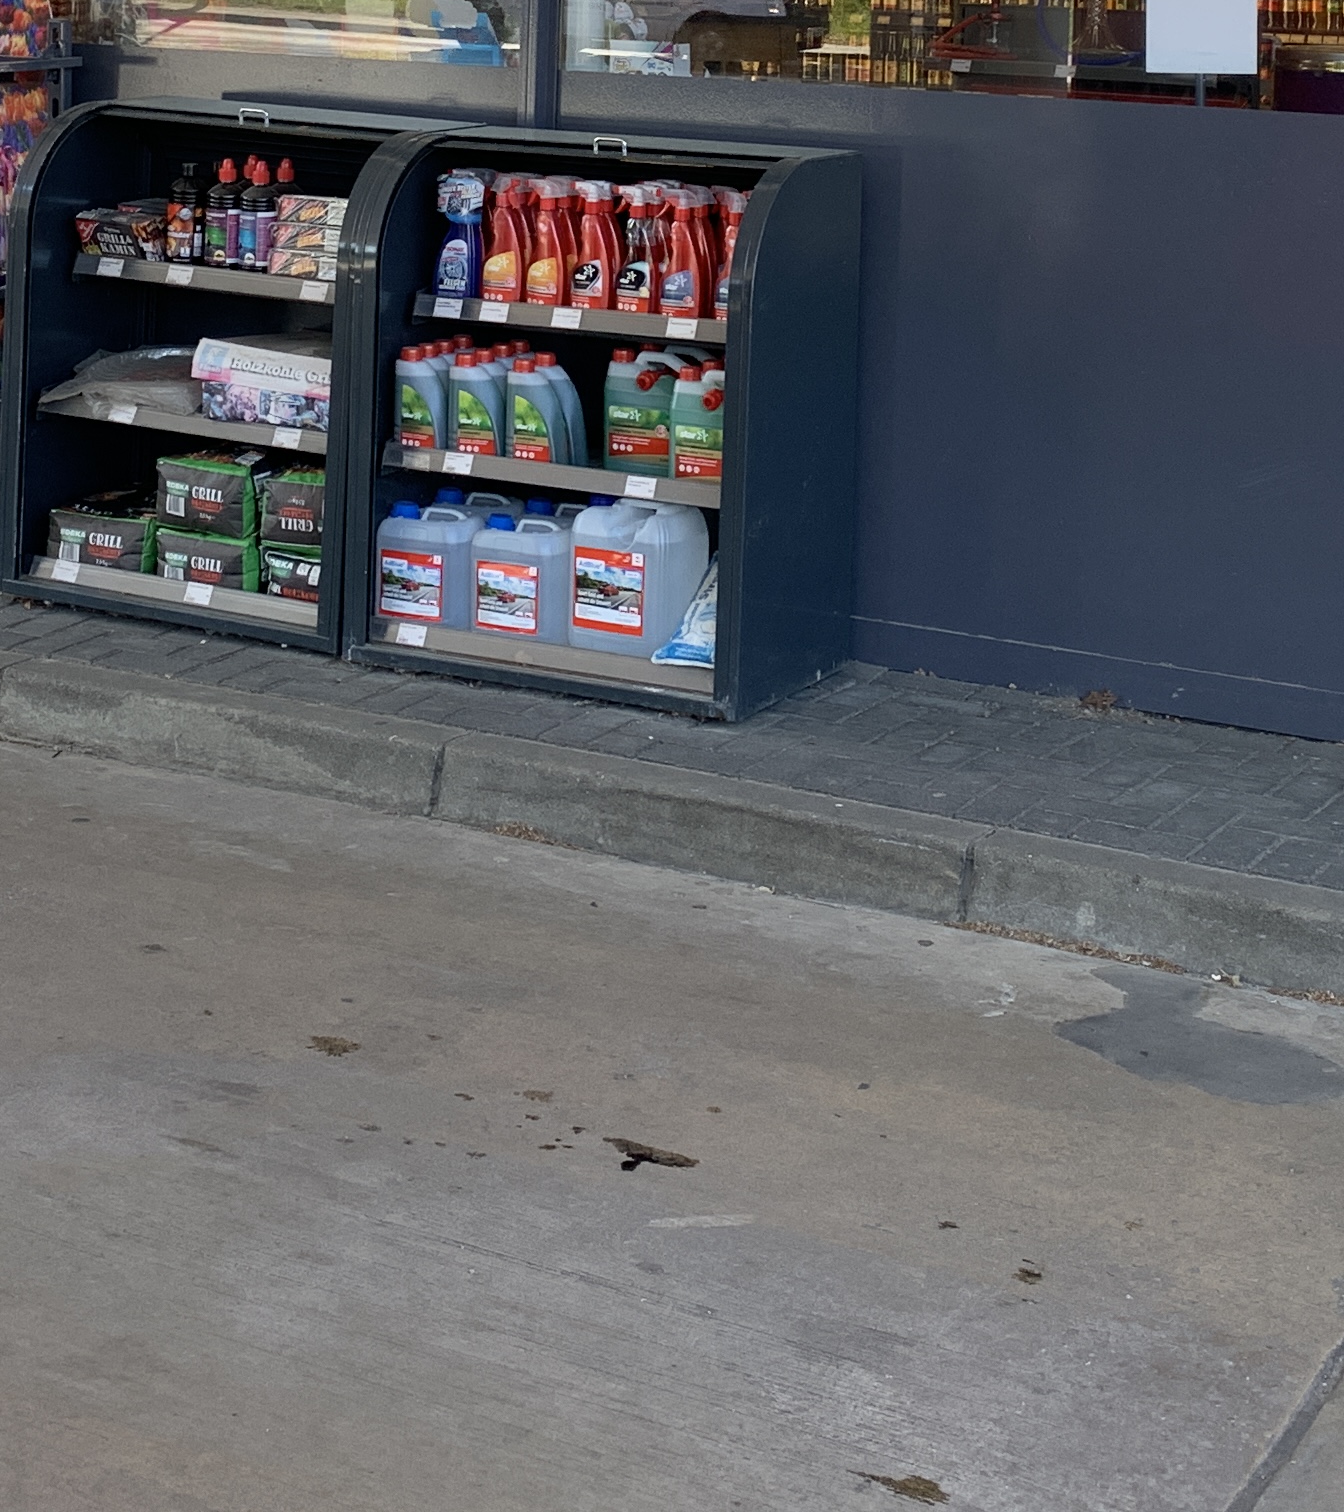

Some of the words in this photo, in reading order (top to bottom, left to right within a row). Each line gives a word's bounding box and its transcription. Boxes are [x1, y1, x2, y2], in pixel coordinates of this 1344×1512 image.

[230, 357, 303, 380] Holzkohle
[191, 485, 224, 504] GRILL
[278, 516, 314, 533] GRILL
[88, 532, 124, 550] GRILL
[190, 555, 223, 574] GRILL
[269, 557, 294, 570] DEKA
